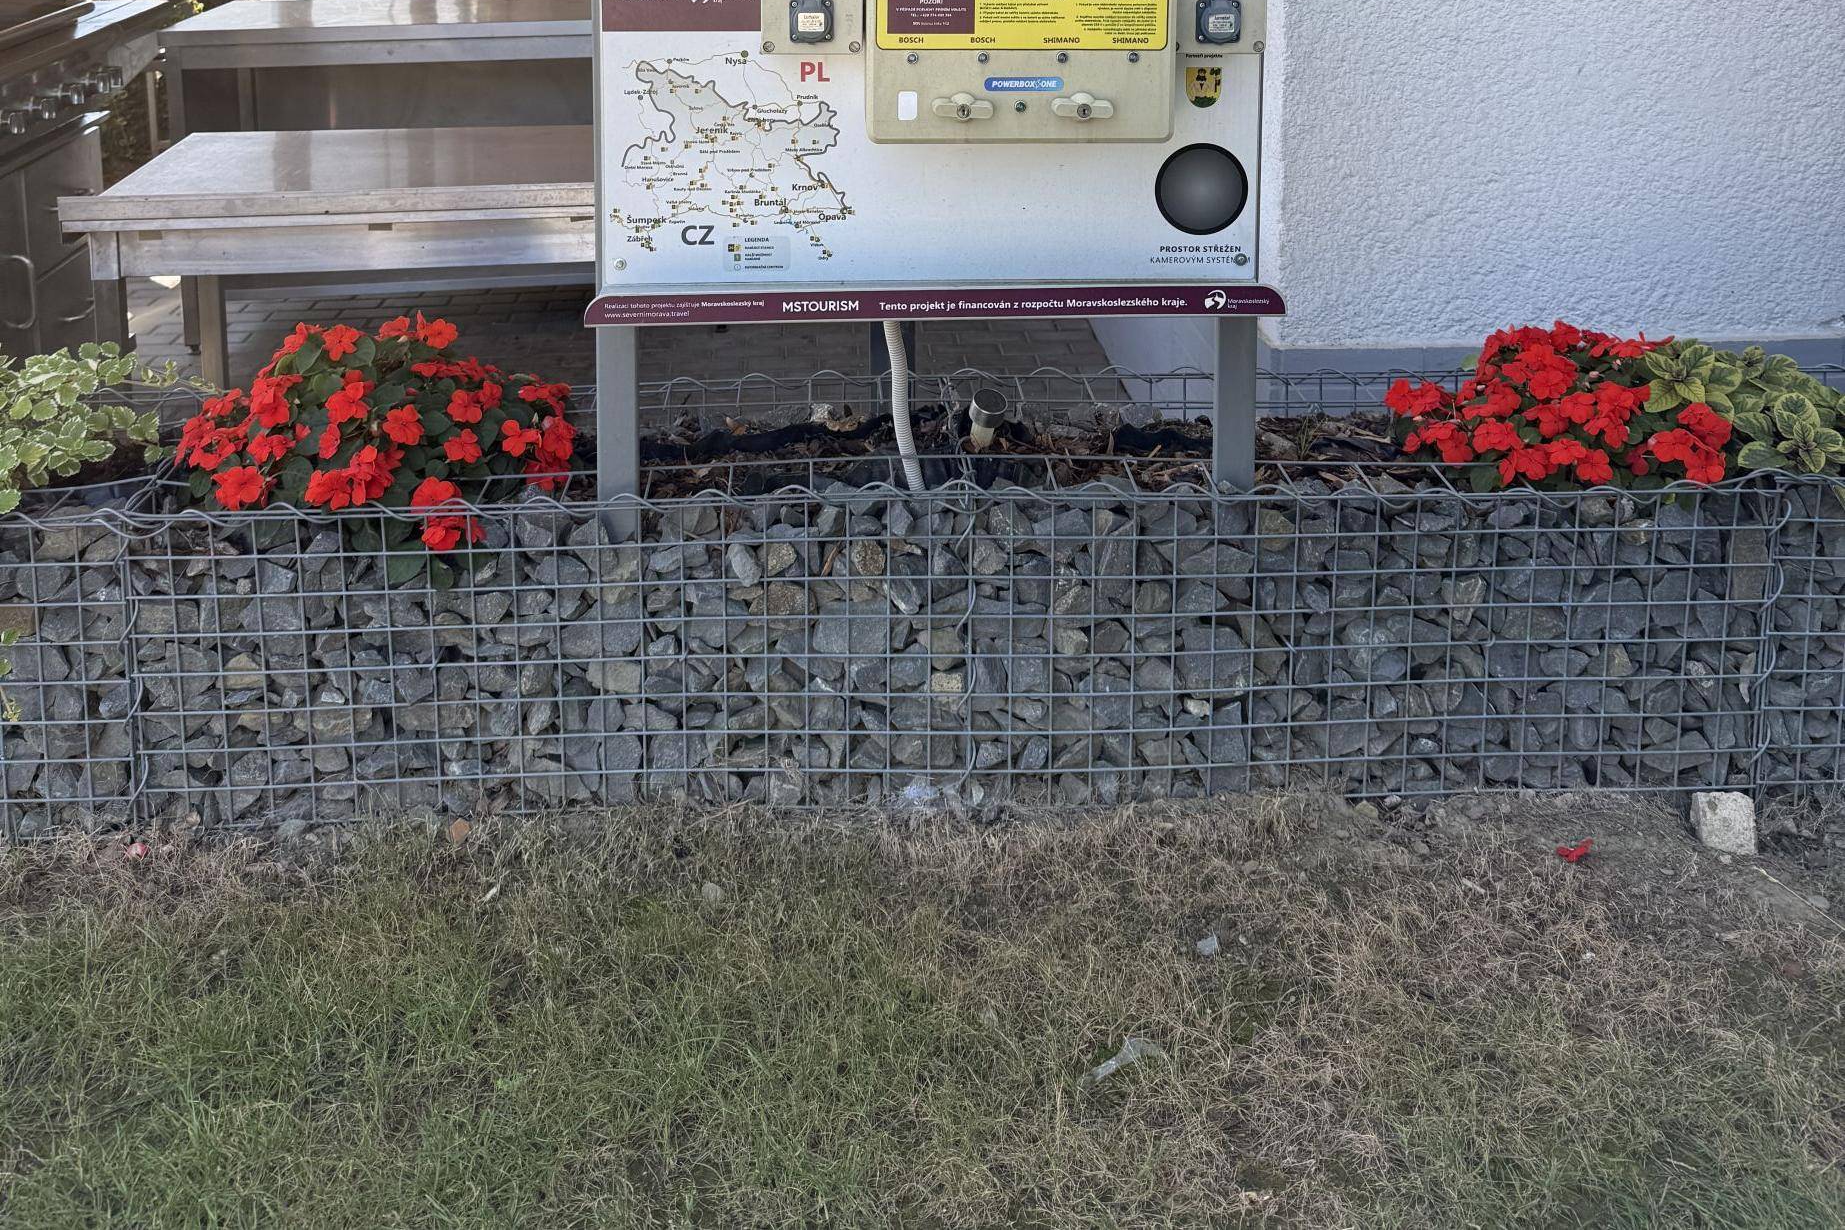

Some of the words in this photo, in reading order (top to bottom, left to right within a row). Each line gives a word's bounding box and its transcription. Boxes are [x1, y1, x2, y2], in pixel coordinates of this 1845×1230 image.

[725, 57, 747, 66] Nysa
[800, 61, 830, 82] PL
[991, 80, 1035, 88] POWERBOX
[696, 126, 728, 134] Jeseník
[792, 183, 818, 191] Krnov
[754, 198, 786, 206] Bruntál
[627, 215, 667, 225] Šumperk
[818, 213, 847, 221] Opava
[681, 225, 714, 246] CZ
[1160, 245, 1200, 253] PROSTOR
[1203, 244, 1241, 253] STŘEŽEN
[1150, 256, 1203, 264] KAMEROVÝM
[651, 302, 675, 310] projektu
[701, 300, 751, 308] Moravskoslezský
[752, 299, 765, 307] kraj
[782, 300, 860, 313] MSTOURISM
[879, 301, 908, 311] Tento
[909, 301, 945, 313] projekt
[946, 301, 956, 312] je
[958, 300, 1011, 310] financován
[1021, 299, 1064, 311] rozpočtu
[1066, 296, 1158, 308] Moravskoslezského
[1161, 297, 1188, 308] kraje.
[604, 310, 690, 319] www.severnimorava.travel
